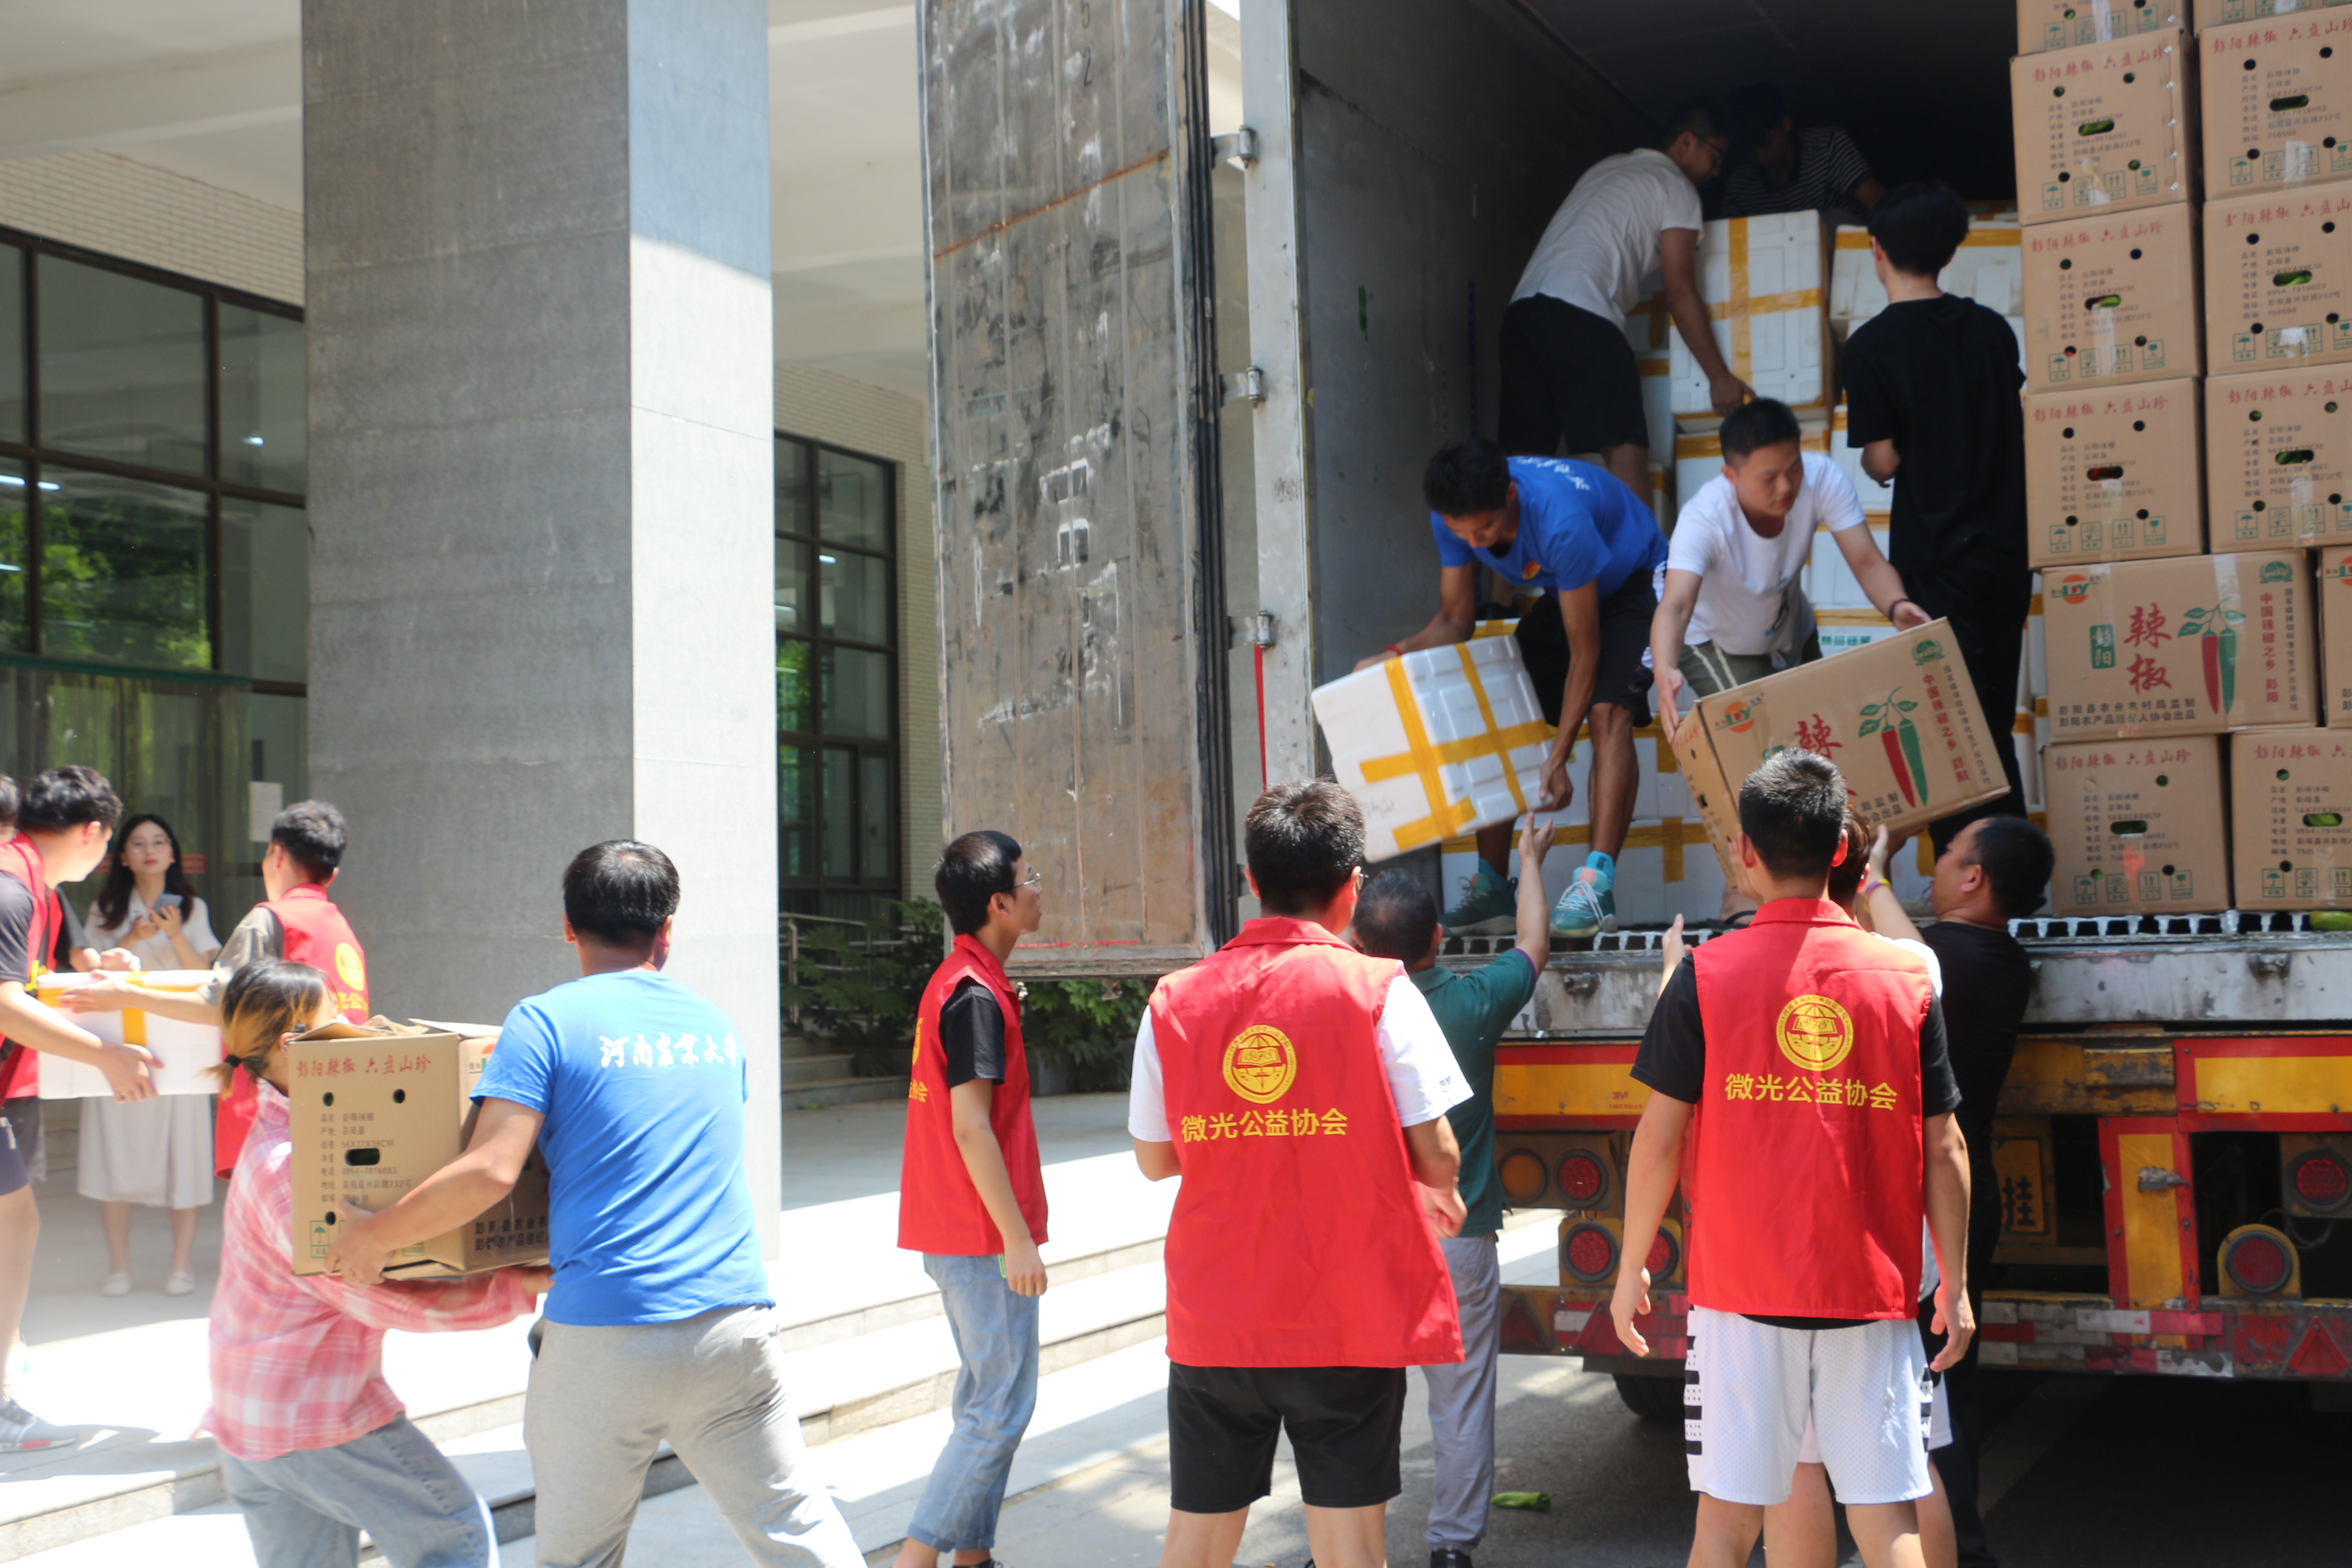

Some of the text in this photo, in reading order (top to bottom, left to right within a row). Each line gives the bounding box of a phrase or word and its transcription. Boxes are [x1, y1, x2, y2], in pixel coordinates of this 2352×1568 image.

[2123, 602, 2173, 696] 辣椒
[1725, 1073, 1898, 1111] 微光公益协会
[1181, 1107, 1348, 1143] 微光公益协会
